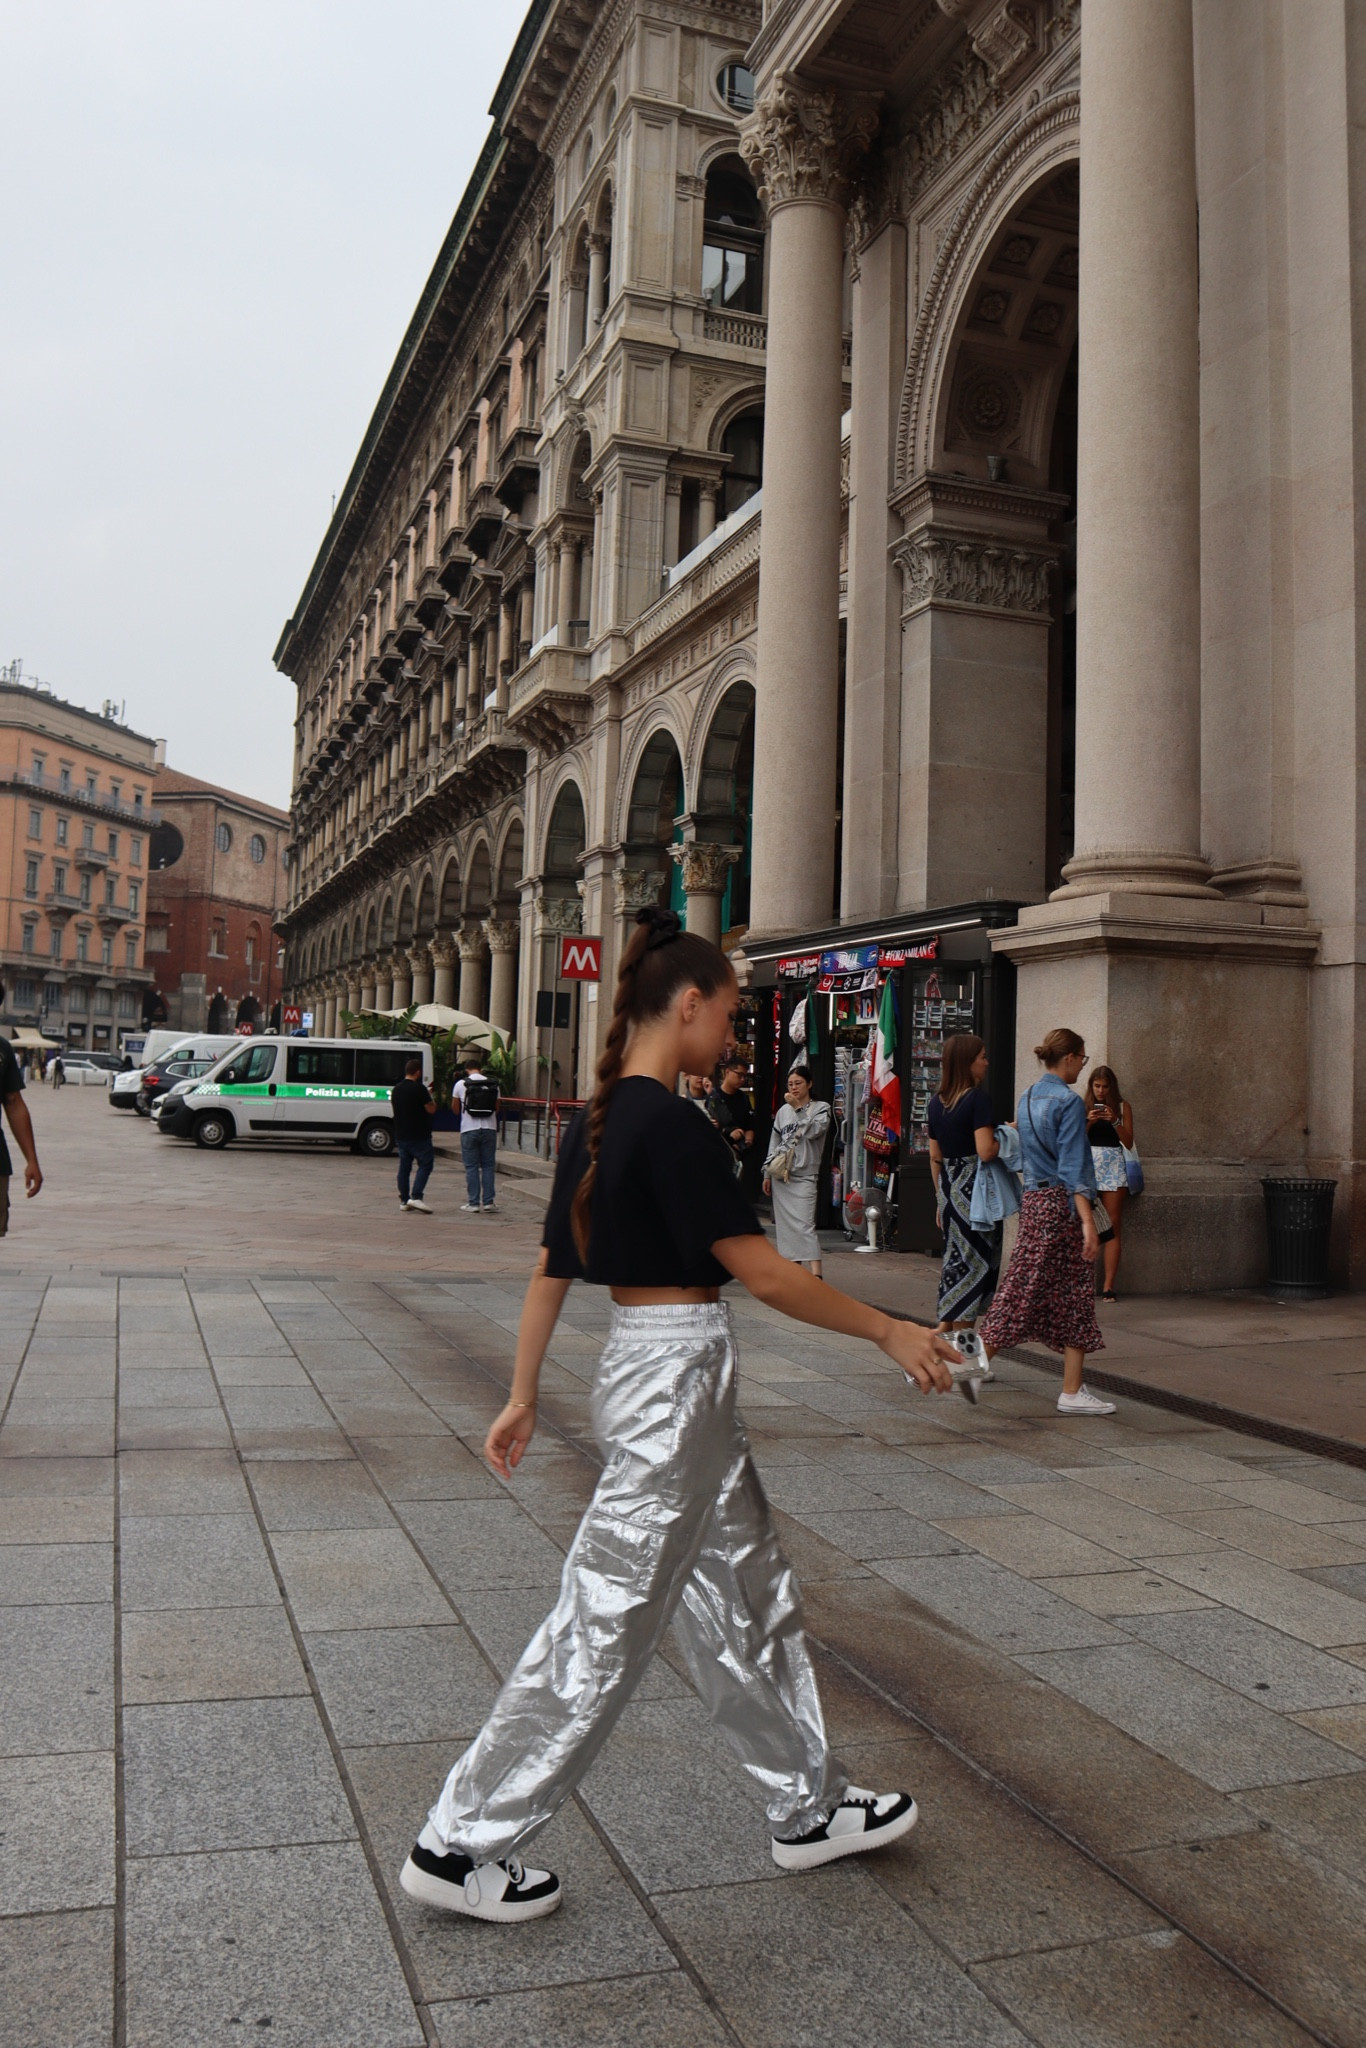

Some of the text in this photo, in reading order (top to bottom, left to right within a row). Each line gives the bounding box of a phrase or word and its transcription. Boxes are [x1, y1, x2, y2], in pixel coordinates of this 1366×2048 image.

[563, 945, 598, 972] M
[885, 944, 928, 961] #FORZAMILAN
[284, 1009, 299, 1021] M
[305, 1087, 376, 1098] Polizia Locale
